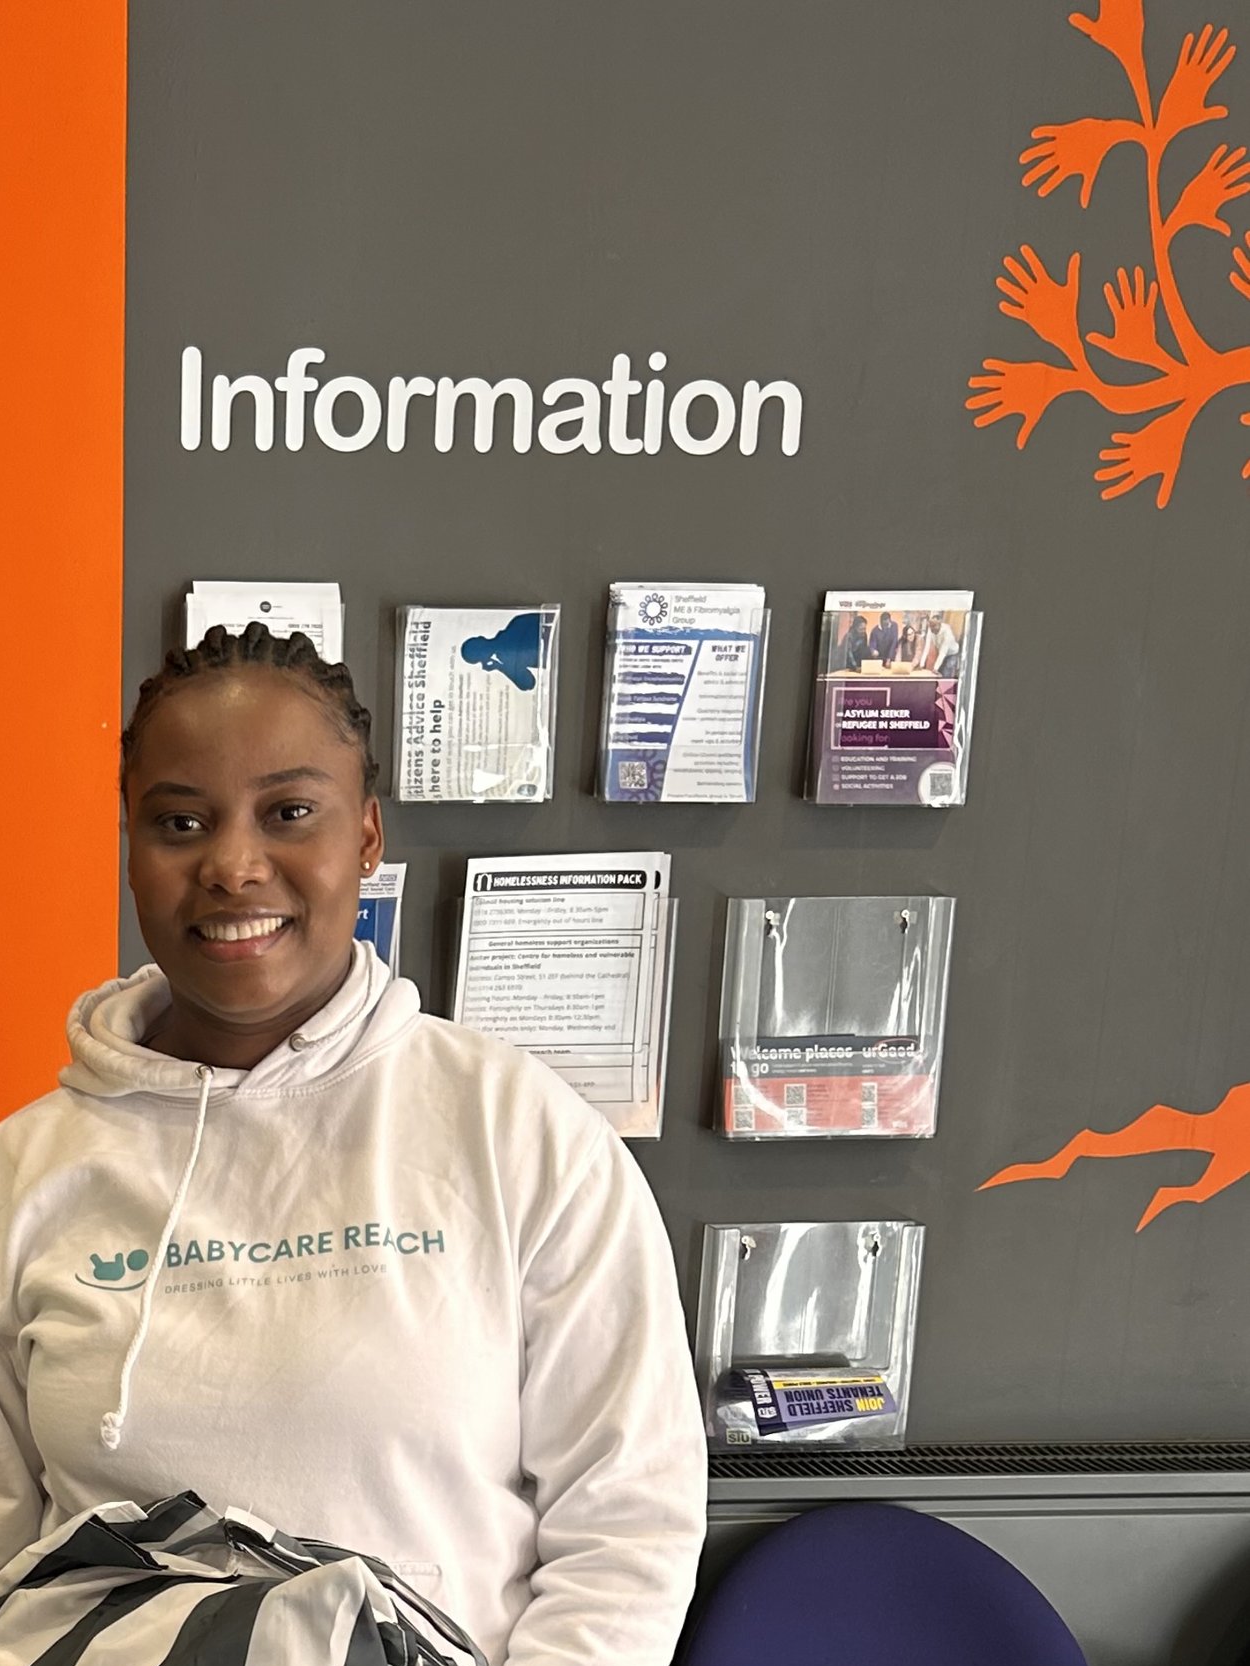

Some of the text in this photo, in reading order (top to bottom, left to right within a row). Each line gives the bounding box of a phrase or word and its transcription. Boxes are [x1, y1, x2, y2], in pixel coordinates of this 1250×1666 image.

[181, 346, 803, 456] Information
[674, 595, 707, 603] Sheffield
[693, 606, 740, 616] Fibromyalgia
[672, 616, 696, 625] Group
[711, 645, 746, 653] WHAT WE
[715, 654, 740, 662] OFFER
[413, 621, 432, 799] tizens Advice Sheffield
[844, 709, 910, 718] ASYLUM SEEKER
[842, 720, 930, 729] REFUGEE IN SHEFFIELD
[429, 700, 445, 793] here to help
[842, 734, 874, 744] ooking
[493, 873, 642, 889] HOMELESSNESS INFORMATION PACK
[547, 939, 572, 947] support
[806, 1044, 853, 1063] places
[750, 1061, 770, 1078] go
[166, 1222, 445, 1269] BABYCARE REACH
[165, 1262, 387, 1295] DRESSING LITTLE LIVES WITH LOVE
[784, 1388, 821, 1404] UNION
[822, 1384, 884, 1399] TENANTS
[787, 1396, 885, 1417] JOIN SHEFFIELD
